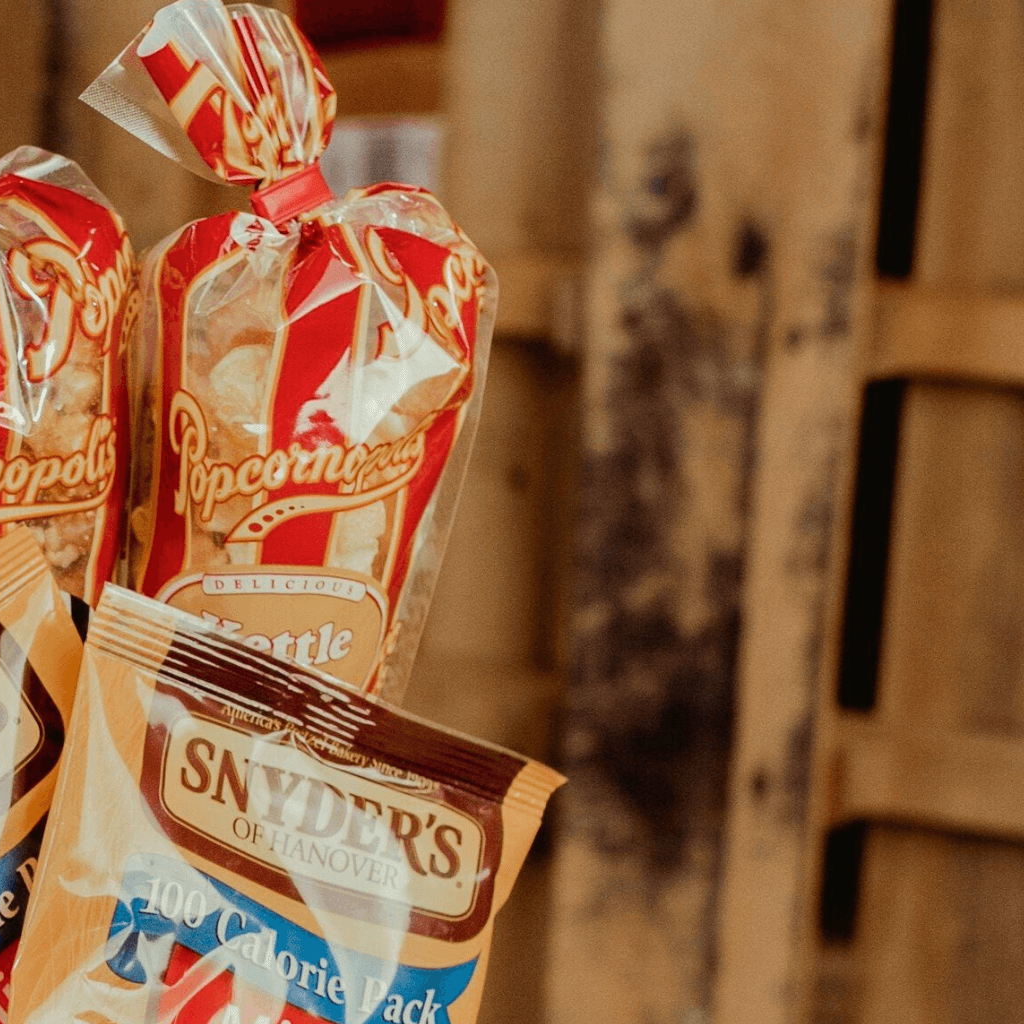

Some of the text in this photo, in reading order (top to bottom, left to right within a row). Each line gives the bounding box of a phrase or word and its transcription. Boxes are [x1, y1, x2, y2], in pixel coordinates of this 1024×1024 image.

[214, 578, 354, 596] DELICIOUS
[180, 737, 463, 880] SNYDER'S
[232, 816, 400, 890] OF HANOVER
[140, 876, 206, 928] 100
[215, 907, 347, 1004] Calorie
